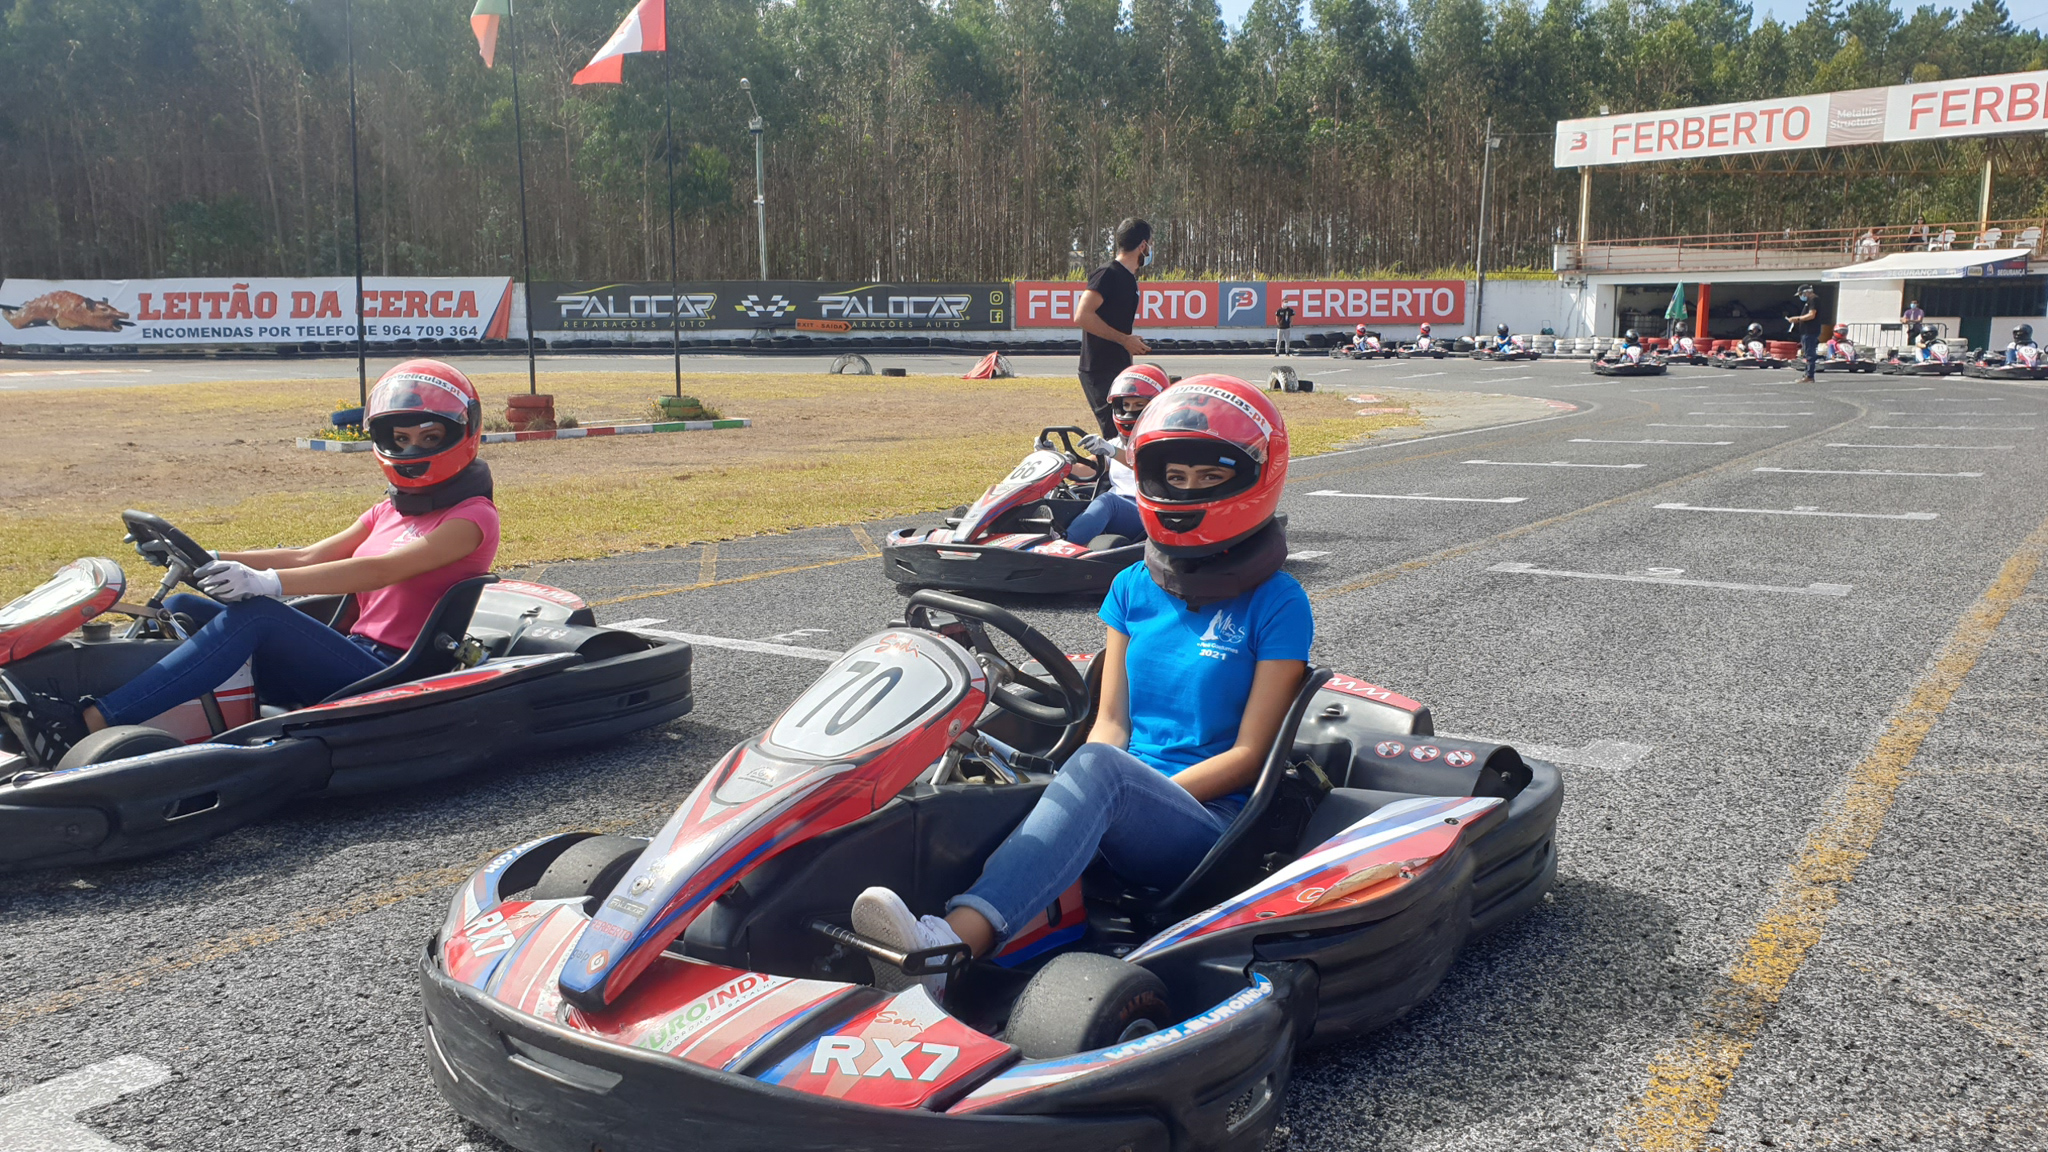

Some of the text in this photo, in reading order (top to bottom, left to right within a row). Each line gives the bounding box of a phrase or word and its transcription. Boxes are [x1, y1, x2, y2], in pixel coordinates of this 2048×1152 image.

[1837, 106, 1878, 119] Metallic
[1909, 82, 2048, 130] FERB
[1611, 105, 1811, 156] FERBERTO
[1829, 115, 1883, 129] Structures
[137, 282, 479, 320] LEITÃO DA CERCA
[555, 293, 717, 319] PALOCAR
[816, 294, 972, 319] PALOCAR
[1029, 289, 1207, 319] FERTO
[1281, 287, 1455, 318] FERBERTO
[142, 326, 254, 339] ENCOMENDAS
[258, 326, 291, 337] POR
[382, 325, 412, 336] 964
[416, 325, 445, 337] 709
[449, 325, 478, 336] 364
[563, 320, 656, 329] REPARAÇÕES
[852, 320, 913, 329] ARAÇÕES
[1199, 648, 1227, 661] 2021
[795, 660, 904, 736] 70
[463, 910, 516, 958] RX7
[590, 919, 633, 942] FERBERTO
[810, 1035, 960, 1082] RX7
